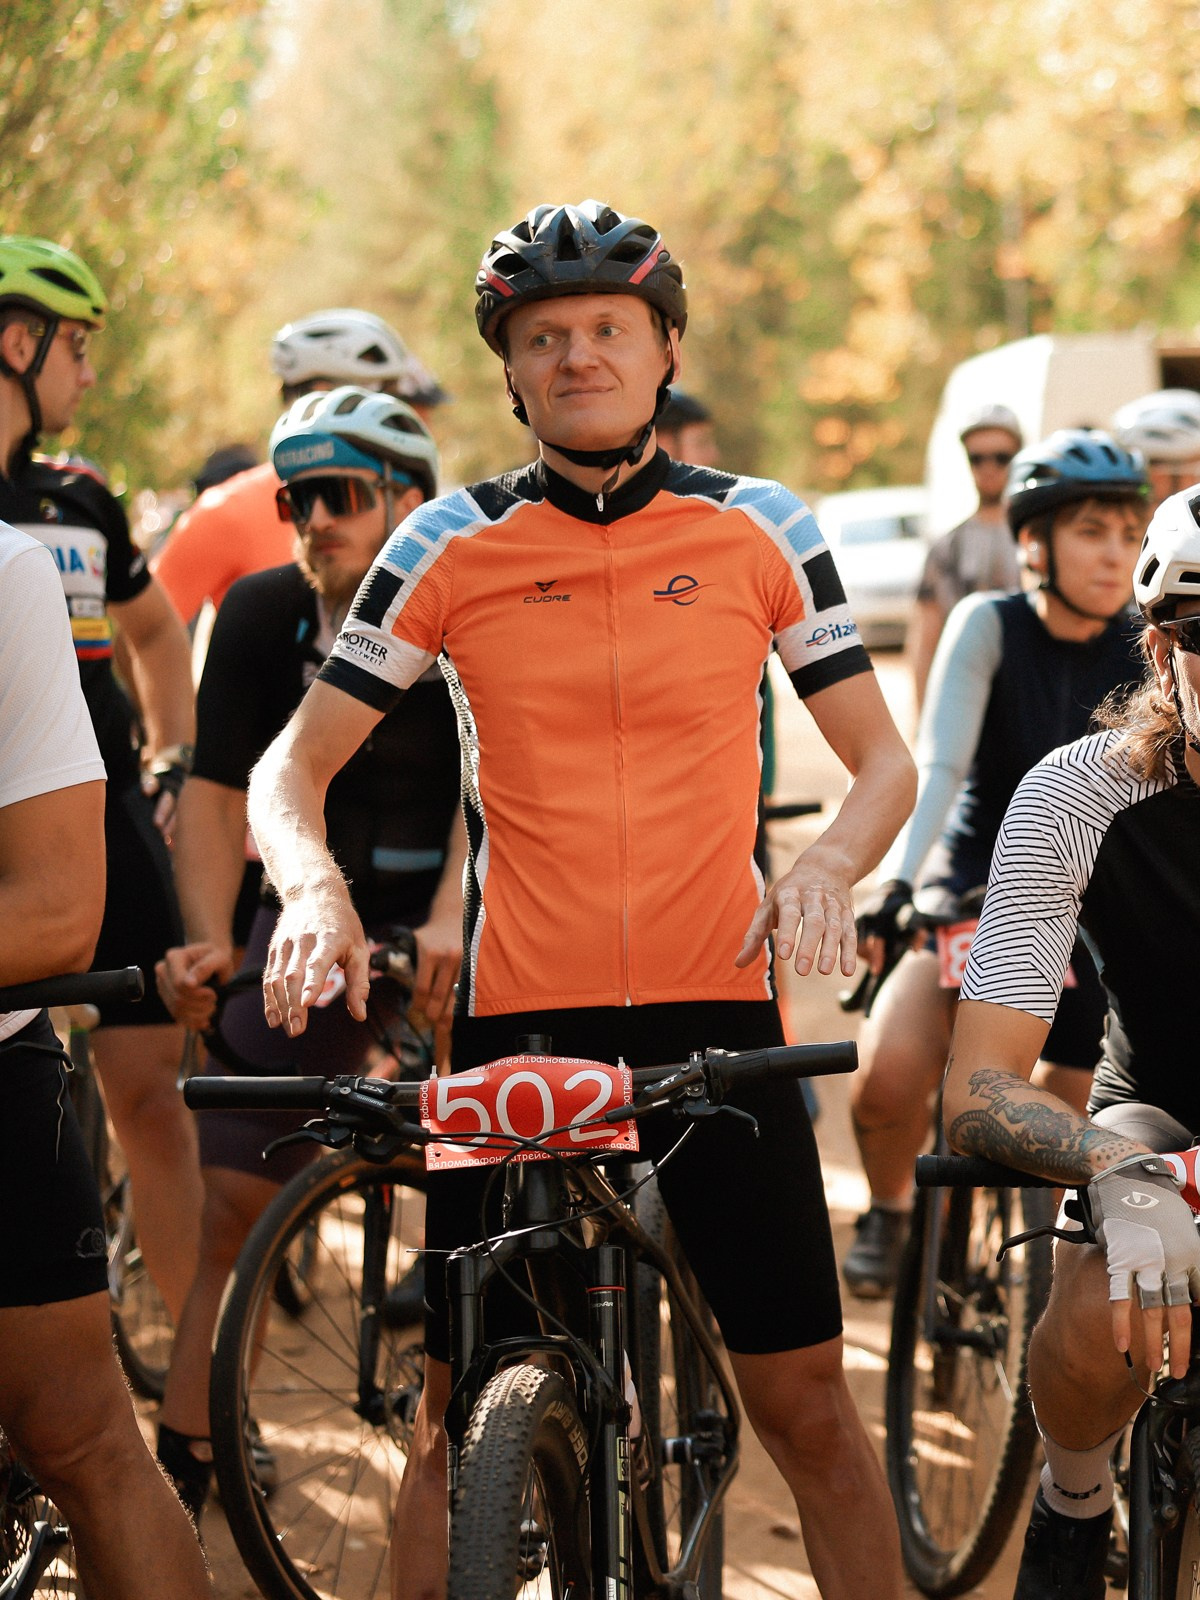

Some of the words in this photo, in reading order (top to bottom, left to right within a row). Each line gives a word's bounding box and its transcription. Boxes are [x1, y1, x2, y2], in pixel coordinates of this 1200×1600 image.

[523, 594, 572, 604] CUORE
[338, 631, 388, 661] ROTTER
[436, 1069, 619, 1153] 502
